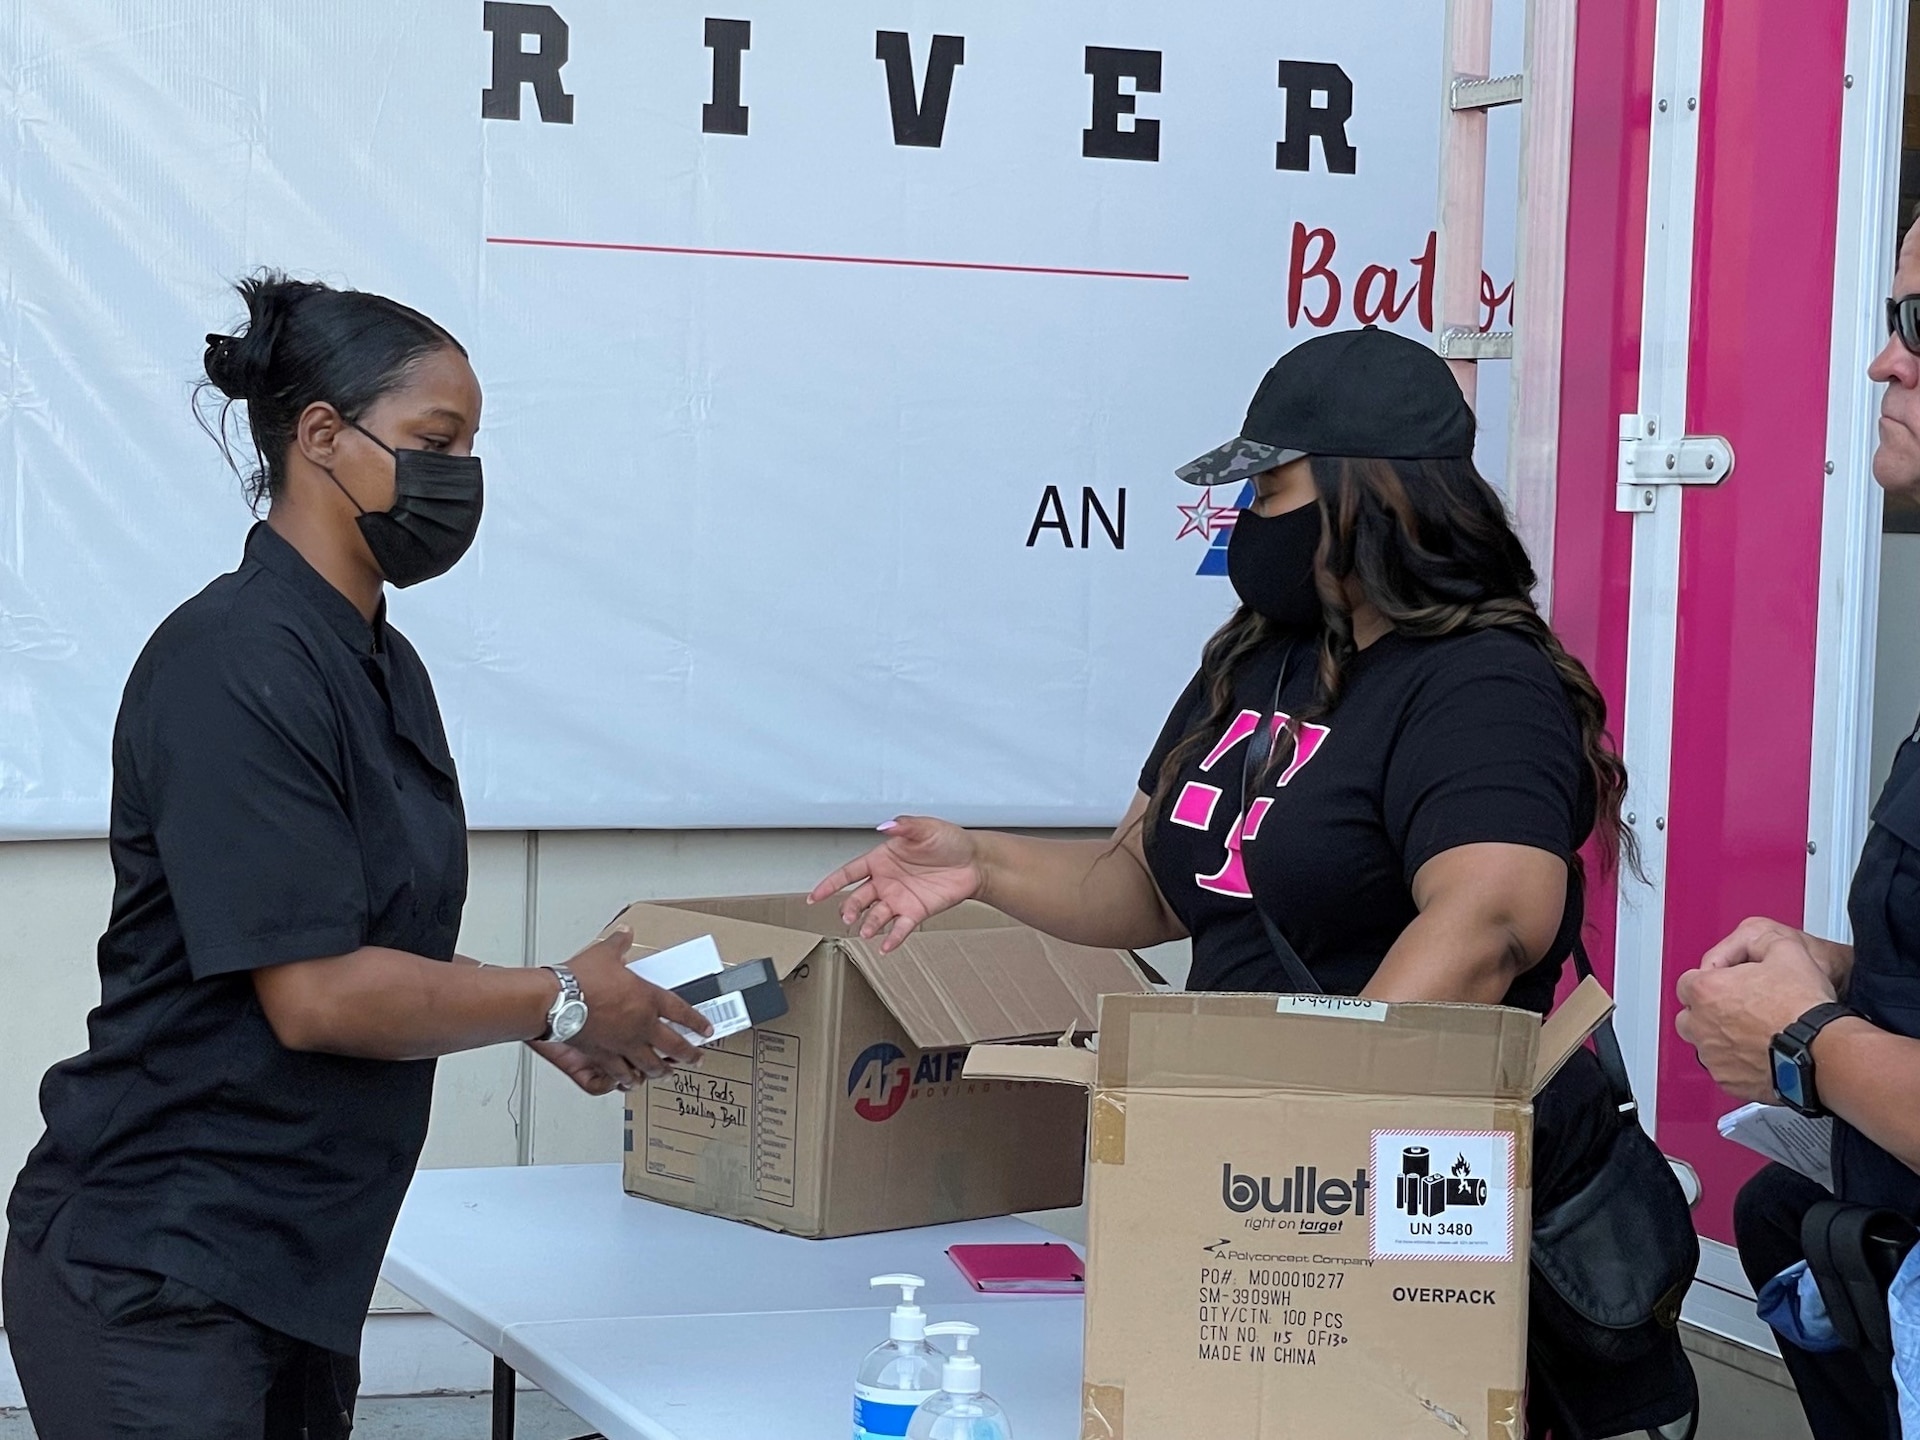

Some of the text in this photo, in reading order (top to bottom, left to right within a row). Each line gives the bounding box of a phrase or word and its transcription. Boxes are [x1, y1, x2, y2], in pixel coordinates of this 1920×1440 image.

[482, 1, 1358, 174] RIVER
[1287, 221, 1514, 333] Bato
[1026, 485, 1126, 550] AN
[673, 1073, 700, 1102] Potty
[910, 1083, 991, 1099] MOVING
[720, 1106, 746, 1128] Ball
[1222, 1163, 1370, 1216] bullet
[1244, 1217, 1343, 1233] right on target
[1410, 1222, 1473, 1236] UN 3480
[1215, 1250, 1375, 1268] A Polyconcept Company
[1249, 1269, 1345, 1289] M000010277
[1392, 1287, 1496, 1305] OVERPACK
[1284, 1309, 1306, 1326] 100
[1313, 1311, 1343, 1329] PCS
[1200, 1325, 1228, 1341] CTN
[1273, 1331, 1293, 1345] 115
[1199, 1343, 1316, 1366] MADE IN CHINA
